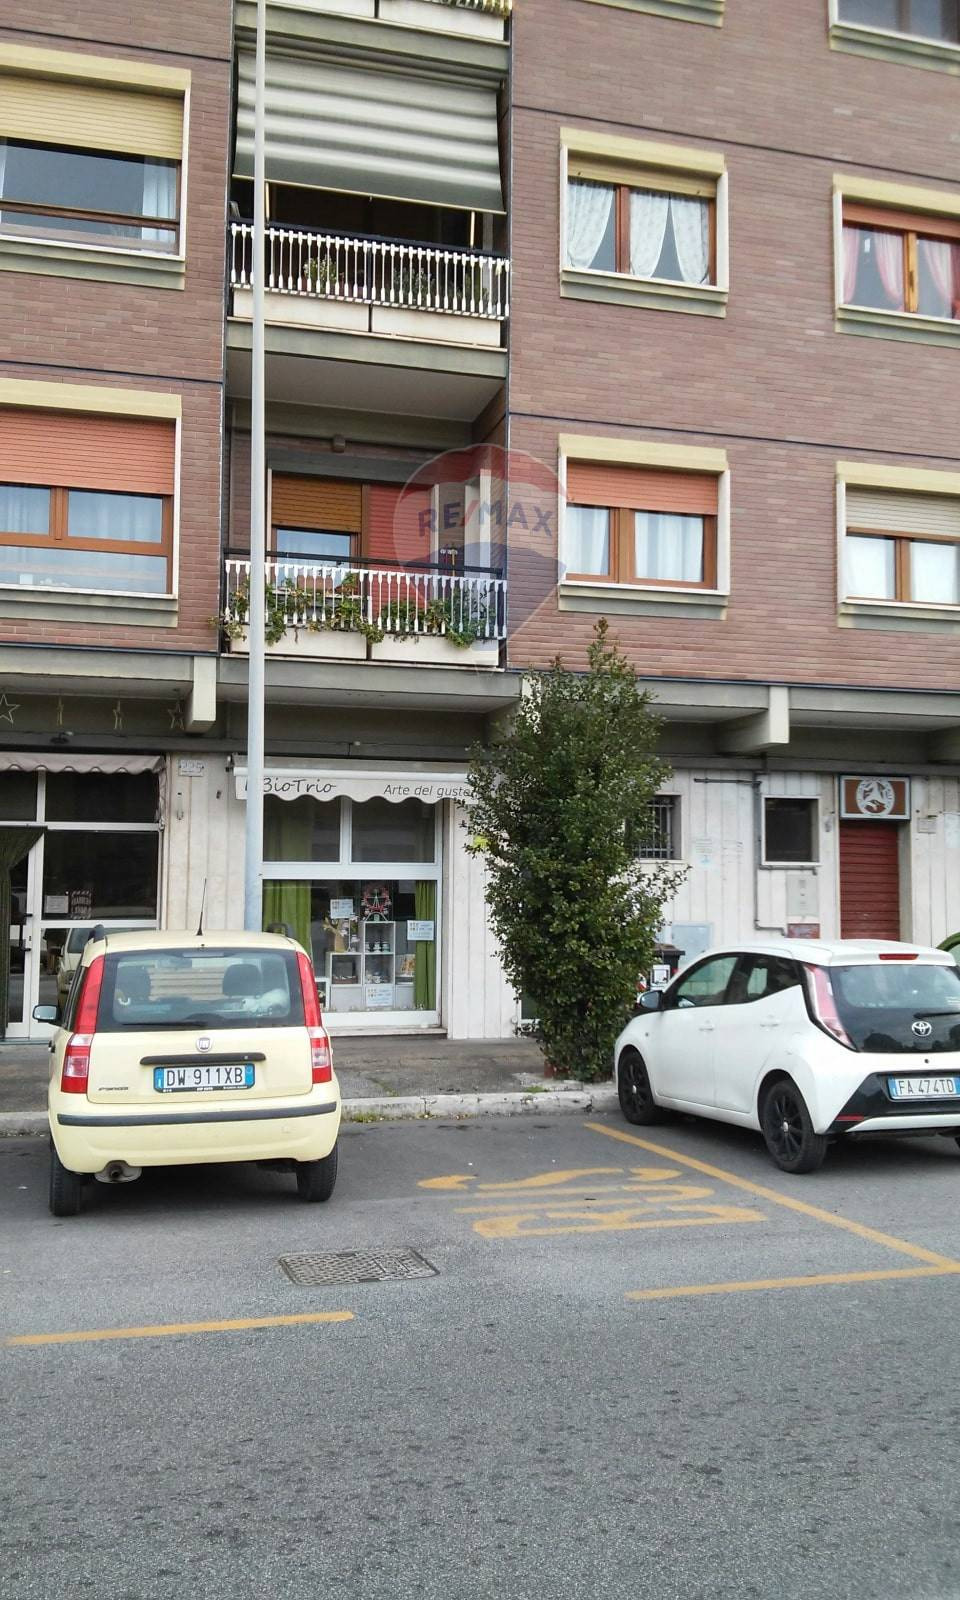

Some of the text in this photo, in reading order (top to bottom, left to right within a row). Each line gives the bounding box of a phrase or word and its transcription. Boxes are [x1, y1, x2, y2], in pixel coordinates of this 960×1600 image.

[384, 784, 410, 796] Arte
[414, 785, 433, 796] del
[166, 1067, 243, 1087] DW 911XB
[899, 1079, 955, 1095] FA 474TD
